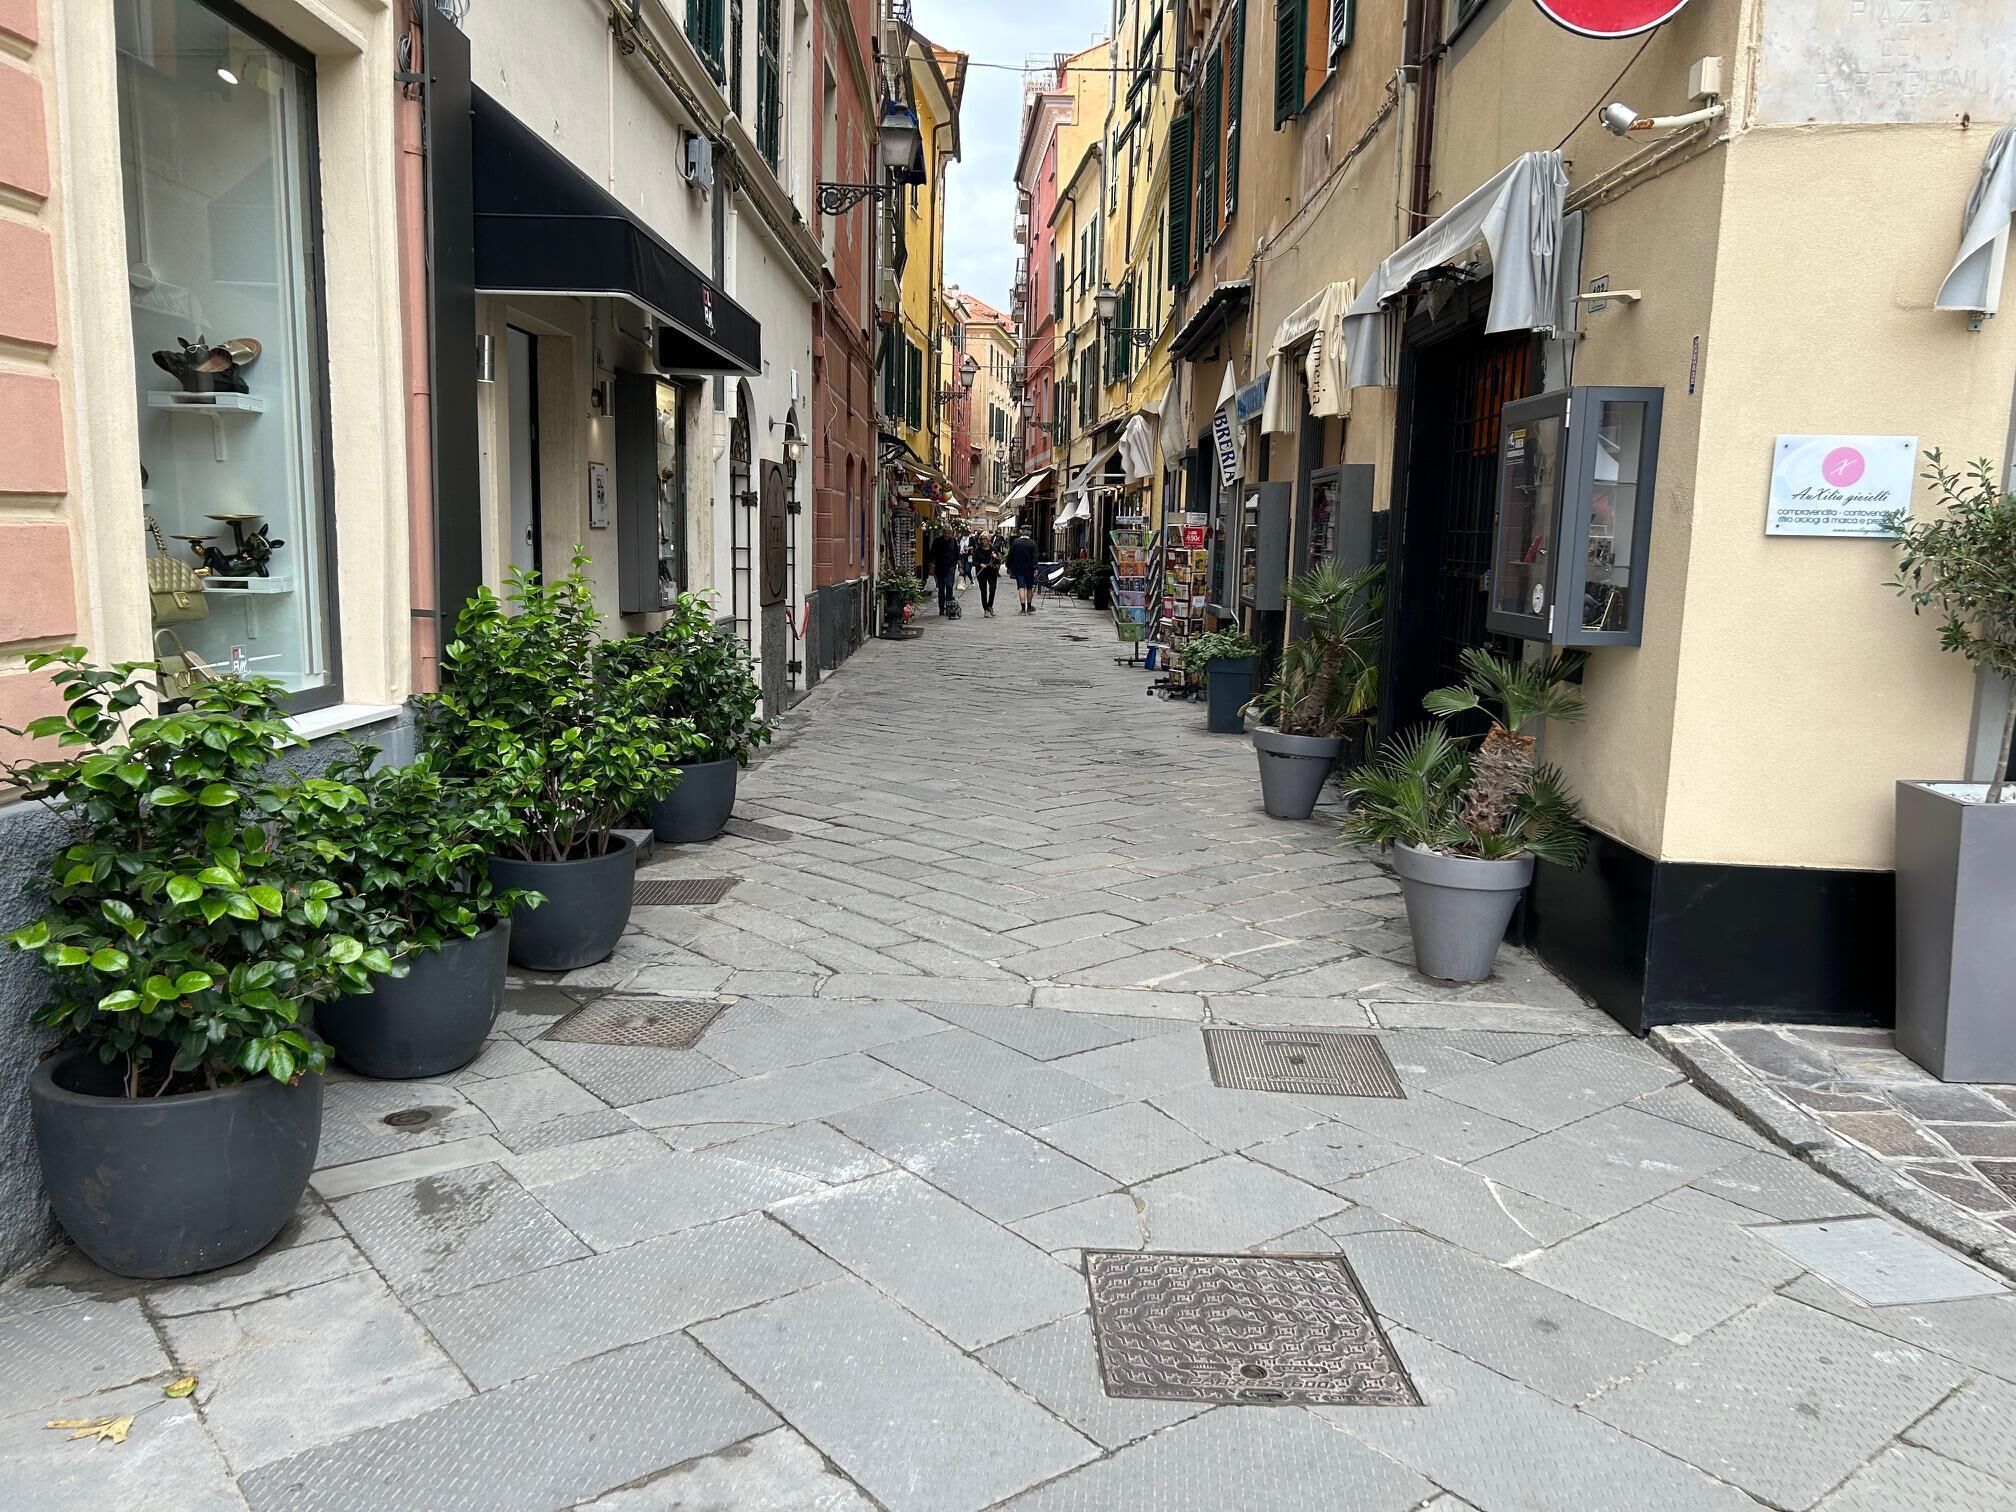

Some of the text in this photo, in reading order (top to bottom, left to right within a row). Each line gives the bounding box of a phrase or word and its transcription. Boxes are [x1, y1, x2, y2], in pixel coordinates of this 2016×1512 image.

[1842, 490, 1890, 506] gioielli
[1777, 508, 1838, 517] compravendita
[1794, 516, 1820, 525] orologi
[1822, 516, 1830, 524] di
